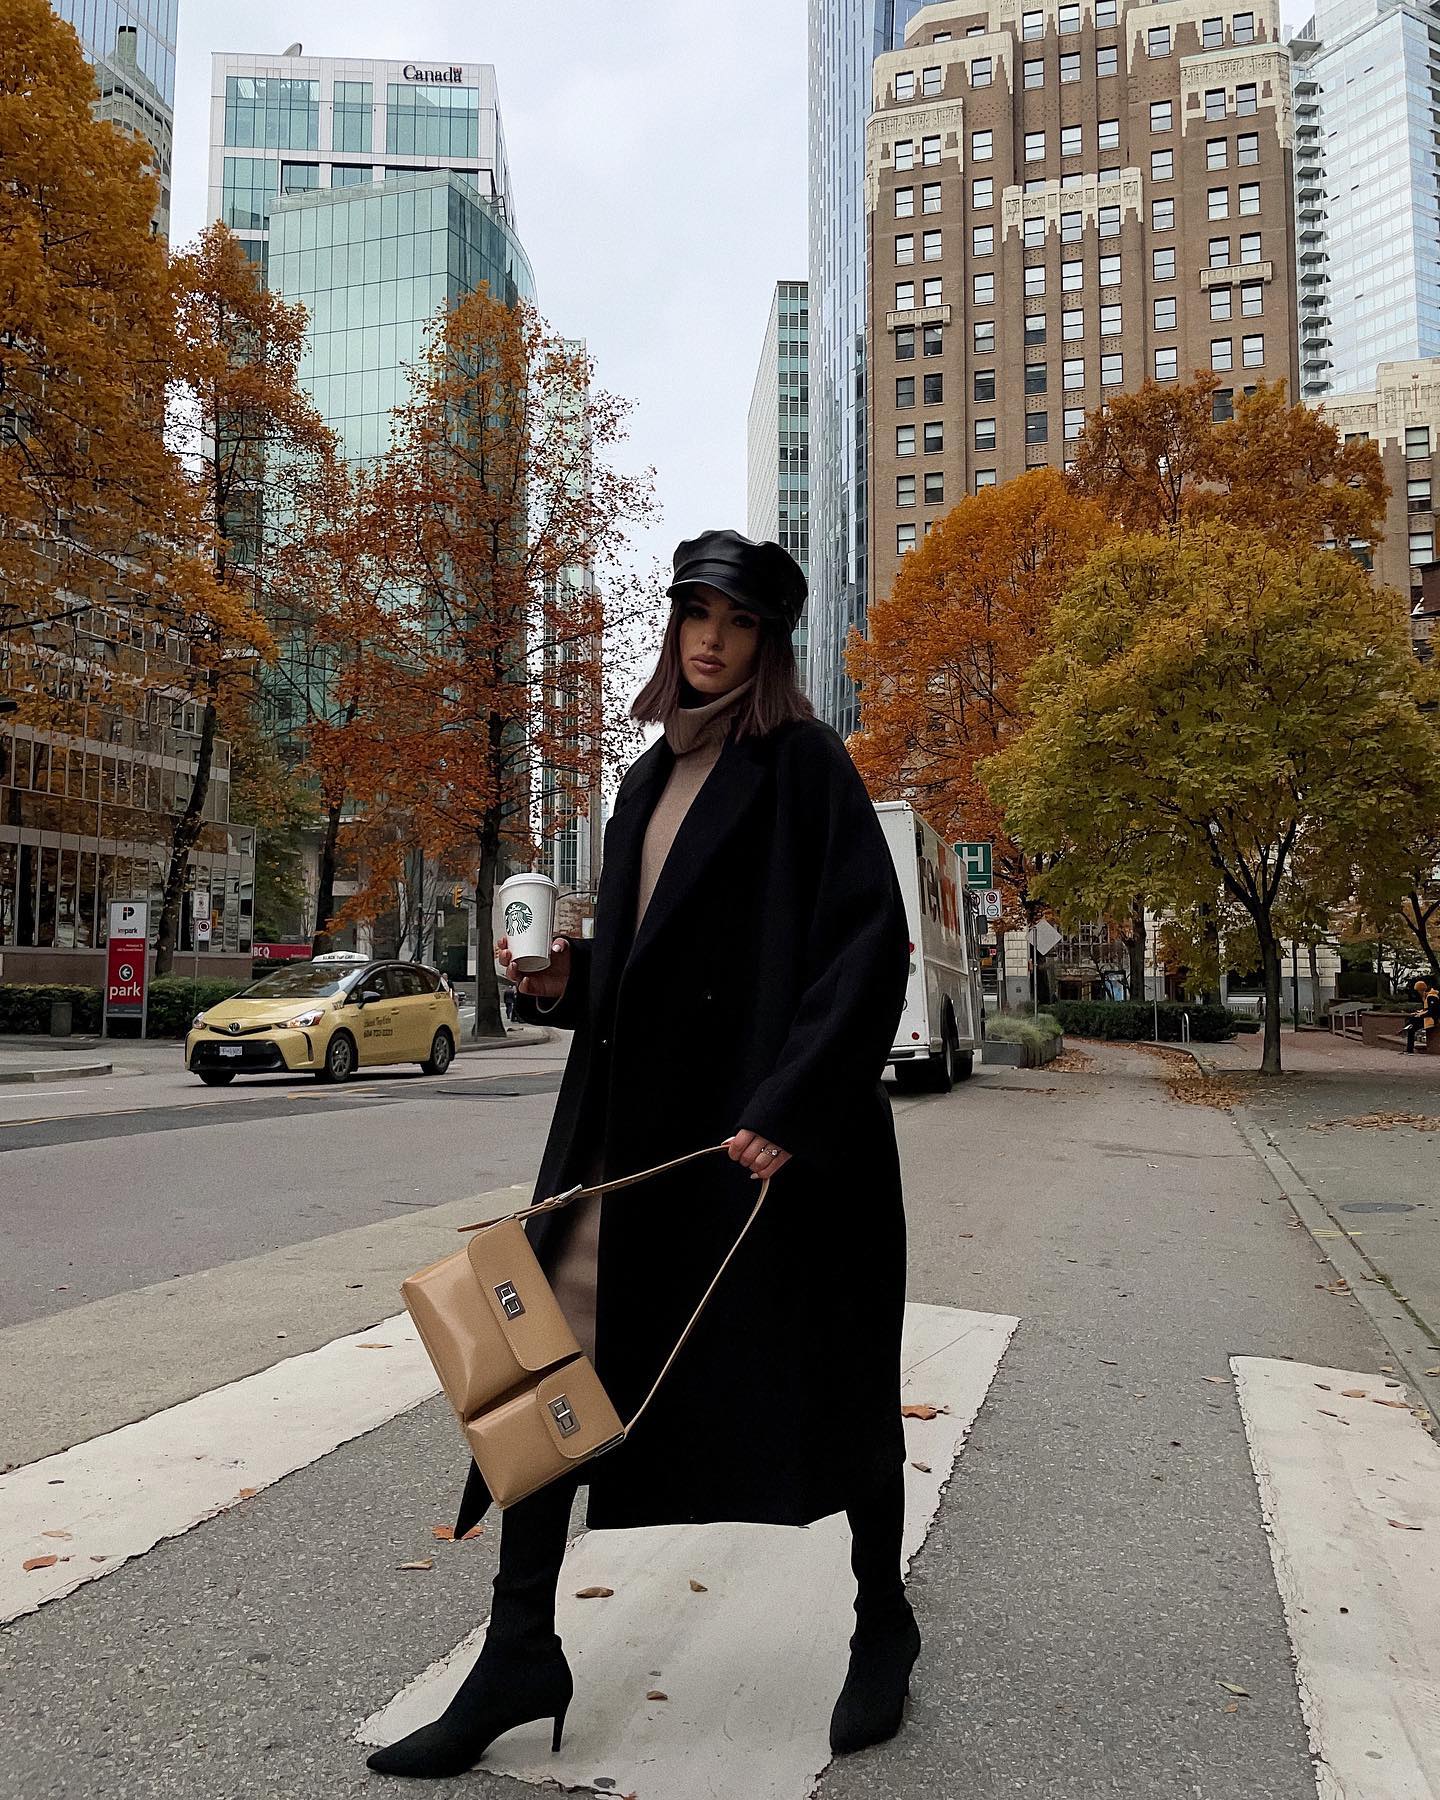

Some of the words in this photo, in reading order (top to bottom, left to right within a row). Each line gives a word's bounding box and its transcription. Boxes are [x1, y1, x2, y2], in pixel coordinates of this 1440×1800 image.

[403, 64, 462, 83] Canada
[963, 847, 983, 872] H
[109, 982, 141, 1000] park
